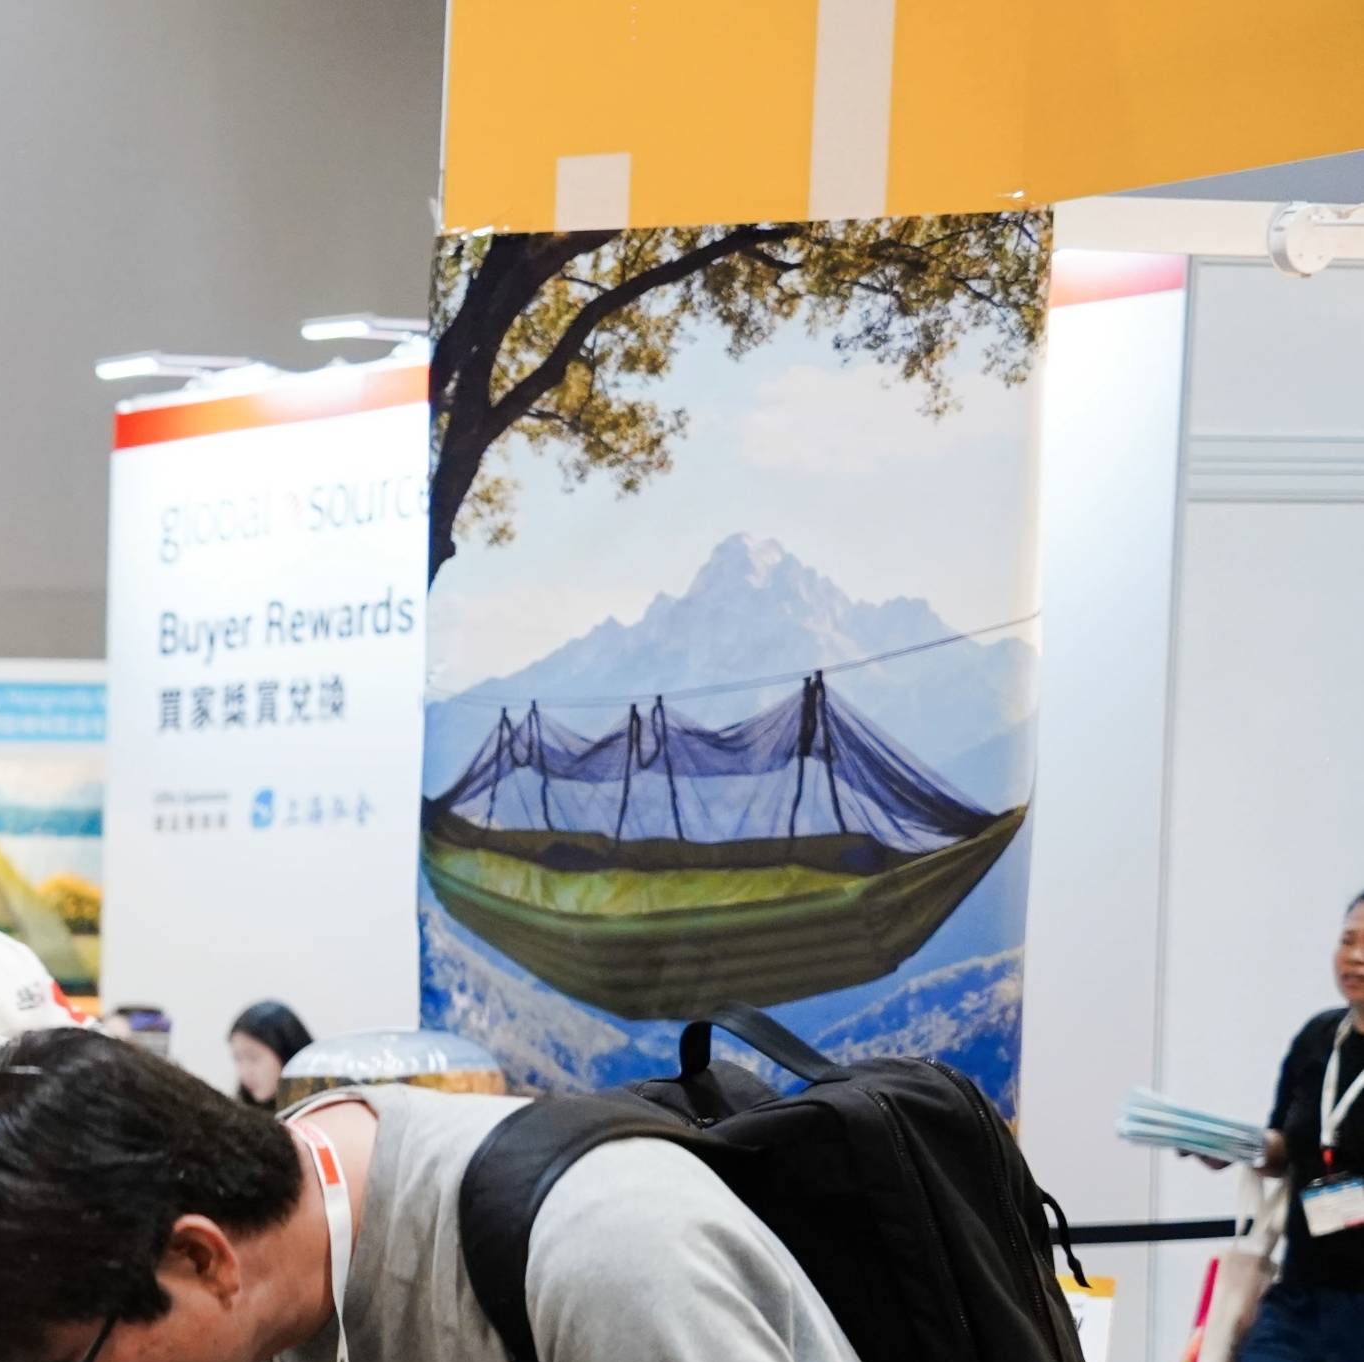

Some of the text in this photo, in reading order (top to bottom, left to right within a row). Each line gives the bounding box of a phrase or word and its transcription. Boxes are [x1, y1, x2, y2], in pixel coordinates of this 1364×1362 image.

[159, 492, 271, 563] global
[157, 588, 416, 663] Buyer Rewards
